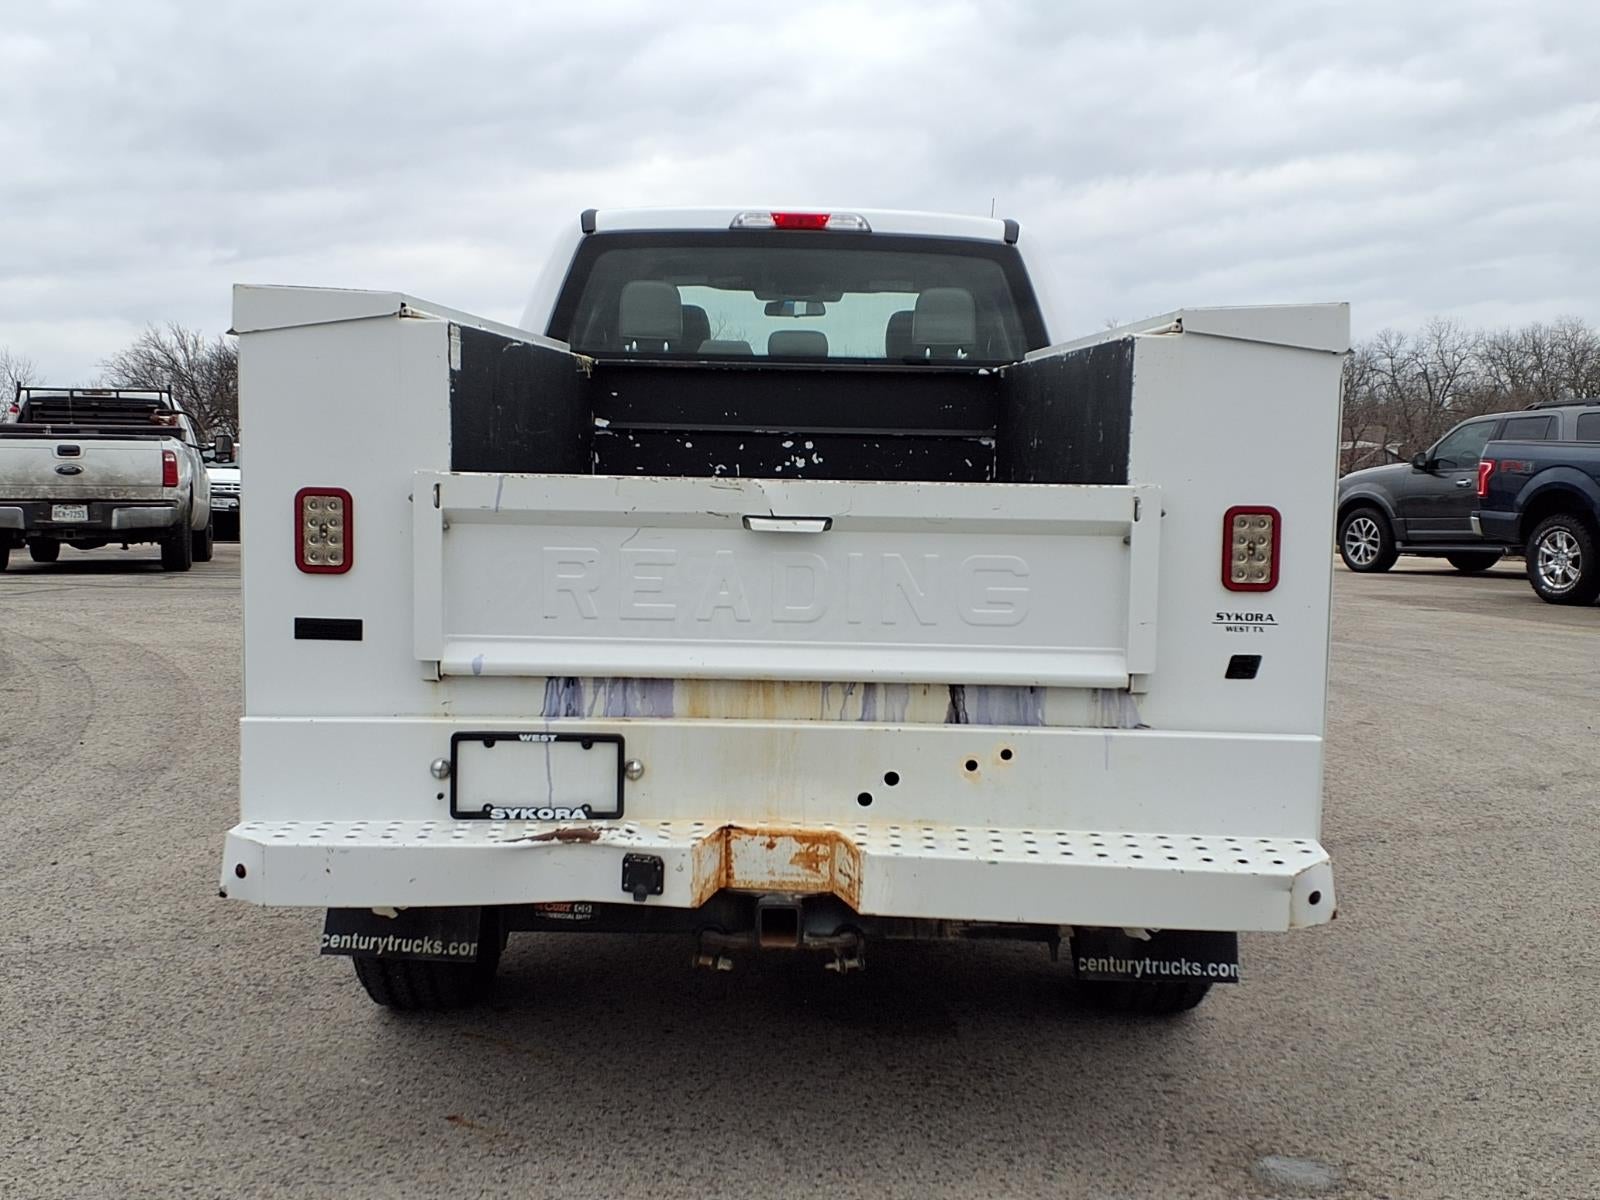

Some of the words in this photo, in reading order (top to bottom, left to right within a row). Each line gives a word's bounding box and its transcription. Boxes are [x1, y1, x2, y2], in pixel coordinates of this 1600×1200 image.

[542, 547, 1030, 628] READING
[1216, 612, 1275, 622] SYKORA
[1225, 625, 1250, 633] WEST
[518, 734, 558, 743] WEST
[490, 807, 588, 821] SYKORA
